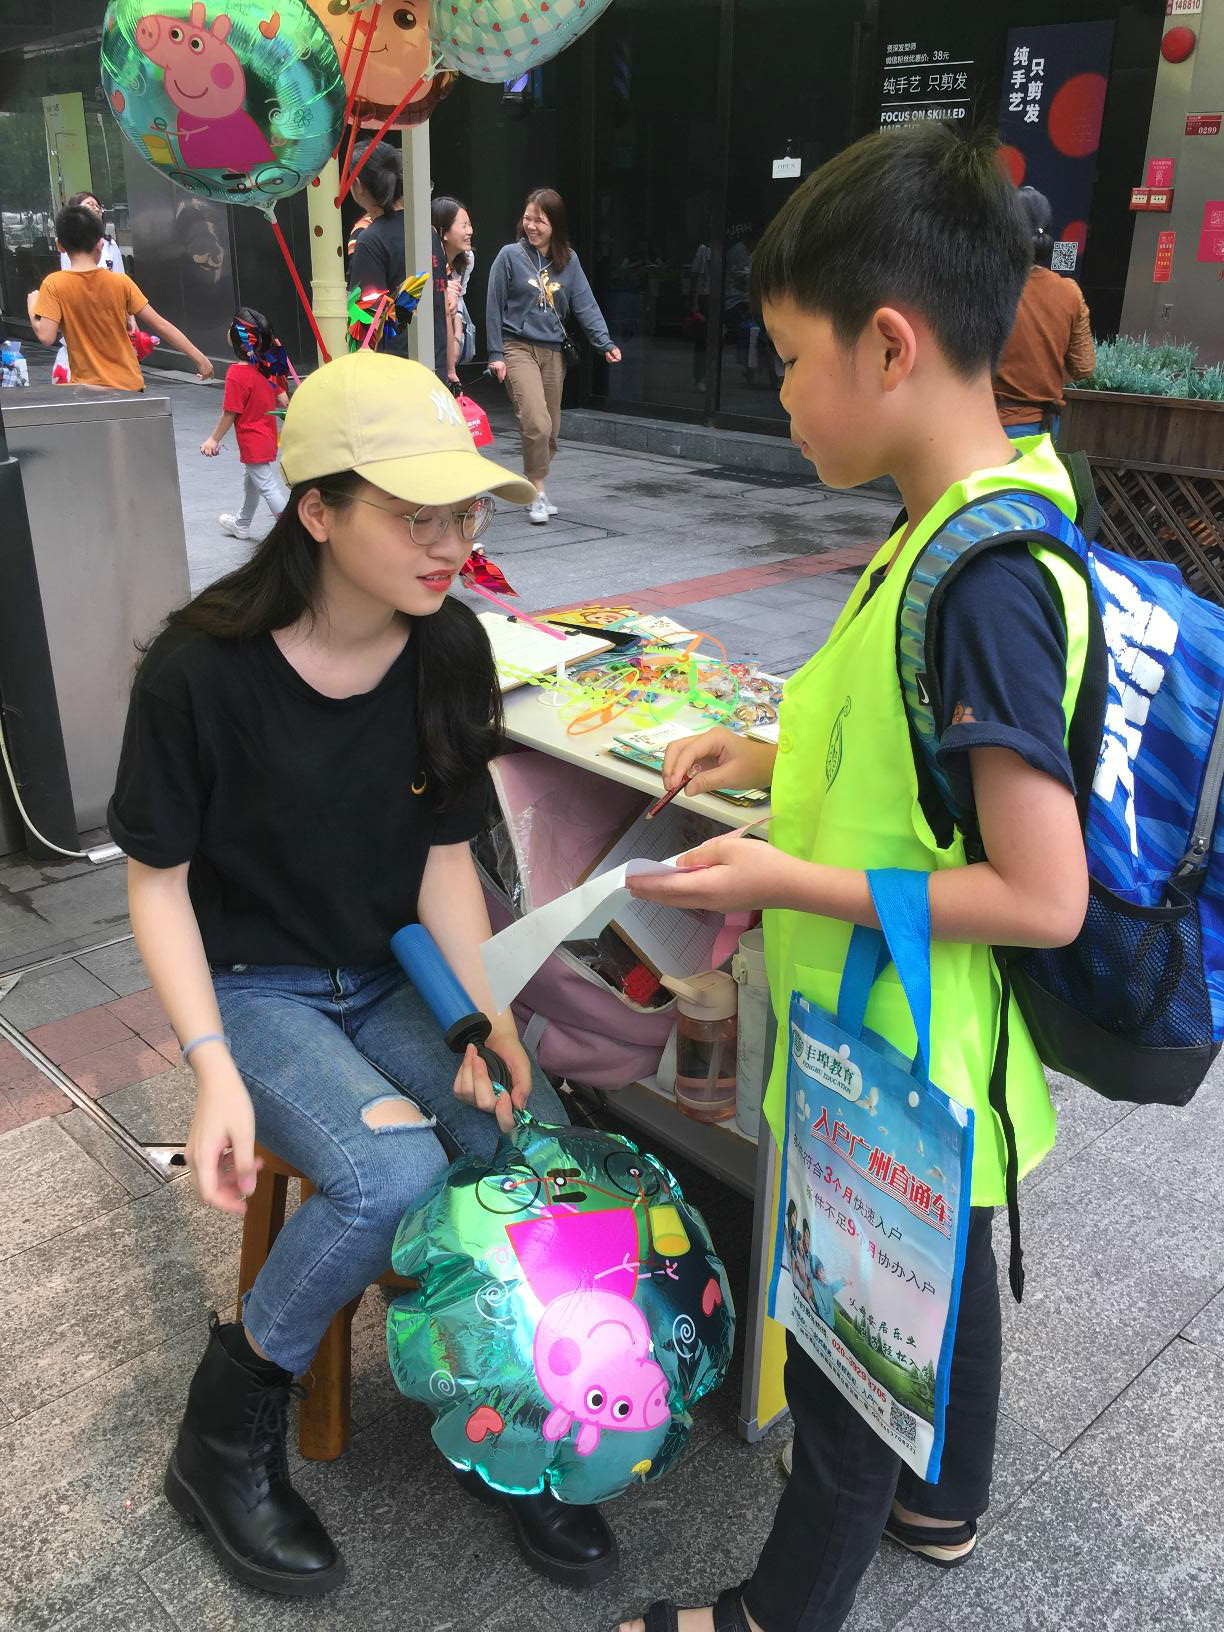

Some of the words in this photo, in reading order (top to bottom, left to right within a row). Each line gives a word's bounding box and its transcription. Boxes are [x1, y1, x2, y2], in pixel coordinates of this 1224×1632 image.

[932, 50, 950, 61] 38元
[883, 75, 921, 95] 纯手艺
[927, 72, 968, 92] 只剪发
[1008, 46, 1030, 112] 纯手艺
[1024, 58, 1045, 123] 只剪发
[880, 111, 911, 122] FOCUS
[911, 110, 926, 121] ON
[927, 108, 966, 120] SKILLED
[1198, 126, 1217, 134] 0299
[822, 1072, 852, 1094] EDUCATION
[812, 1106, 953, 1224] 入户广州直通车
